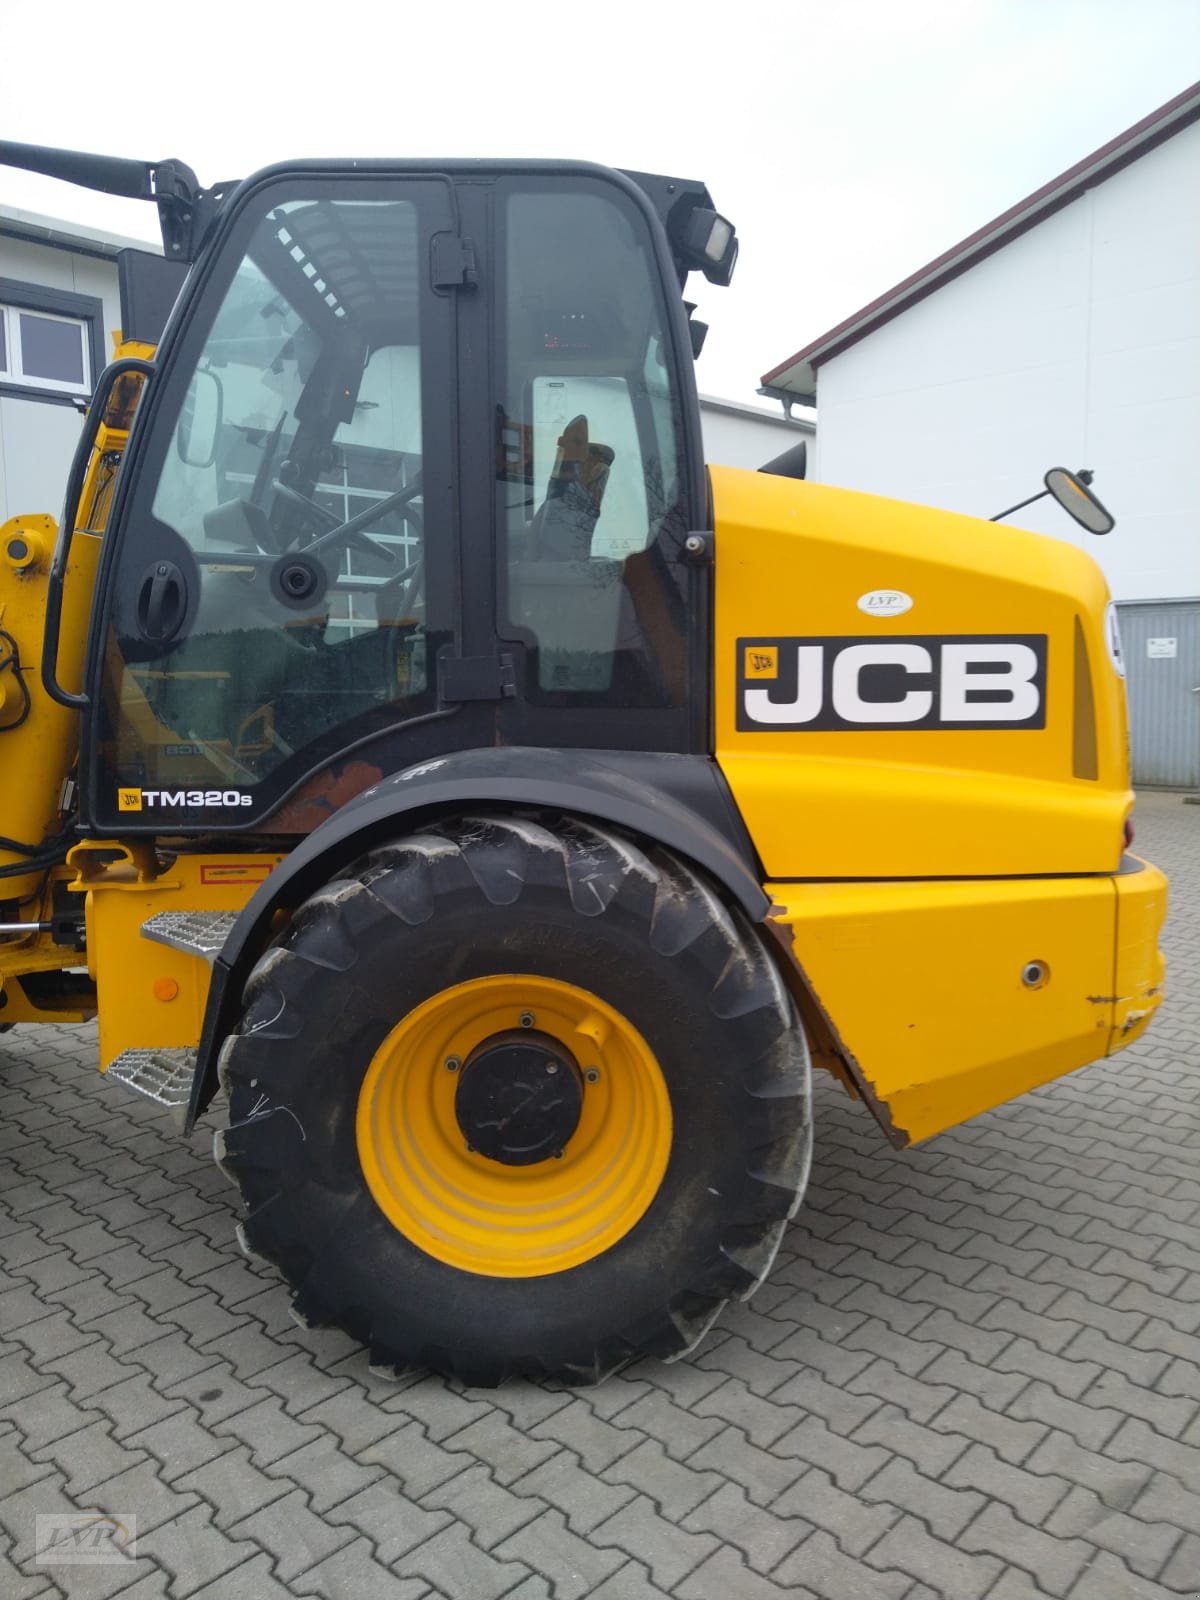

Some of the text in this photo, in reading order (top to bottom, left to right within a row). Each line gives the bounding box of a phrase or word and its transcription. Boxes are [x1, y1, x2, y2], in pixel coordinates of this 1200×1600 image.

[866, 596, 898, 606] LVP
[751, 654, 772, 670] JCB
[744, 643, 1040, 724] JCB
[141, 790, 253, 807] TM320s
